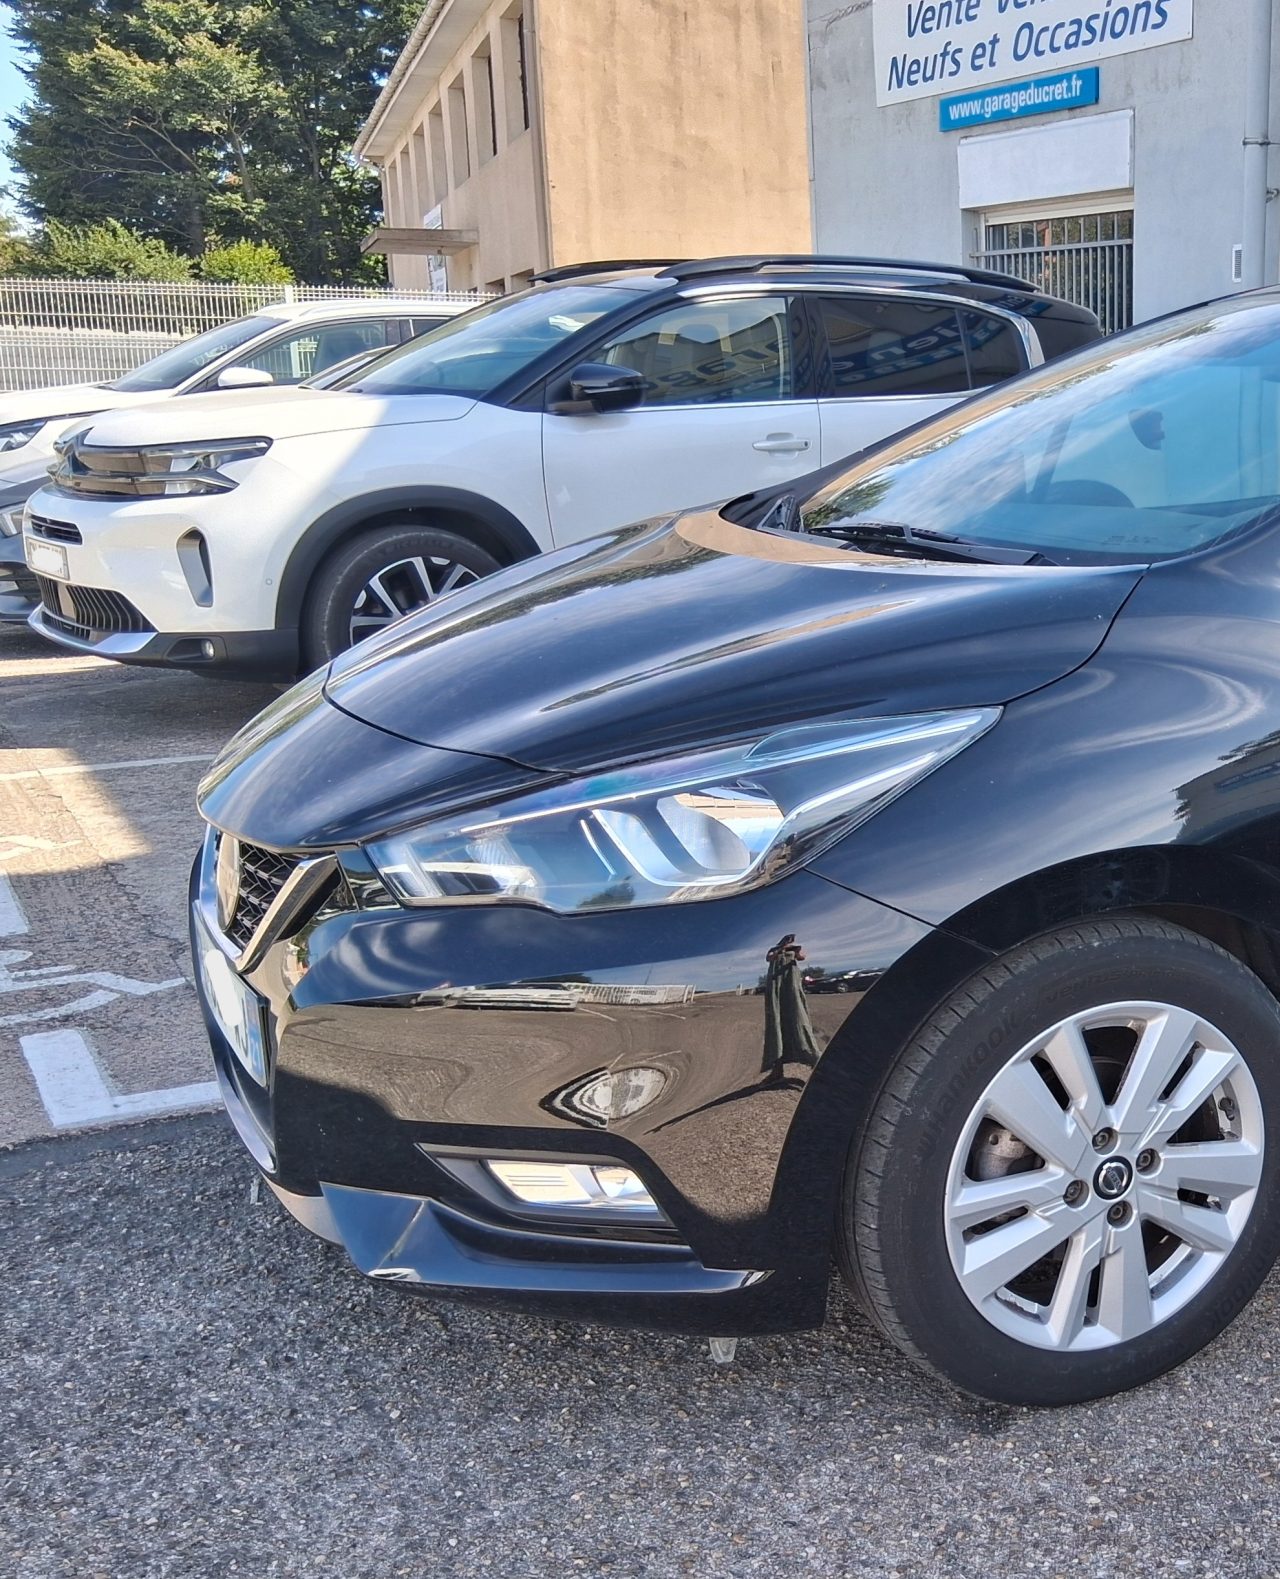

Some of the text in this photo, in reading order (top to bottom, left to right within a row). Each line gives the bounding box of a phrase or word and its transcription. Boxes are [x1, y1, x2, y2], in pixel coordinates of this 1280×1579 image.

[907, 0, 980, 38] Vente
[888, 0, 1171, 91] Neufs et Occasions
[949, 74, 1083, 121] www.garageducret.fr
